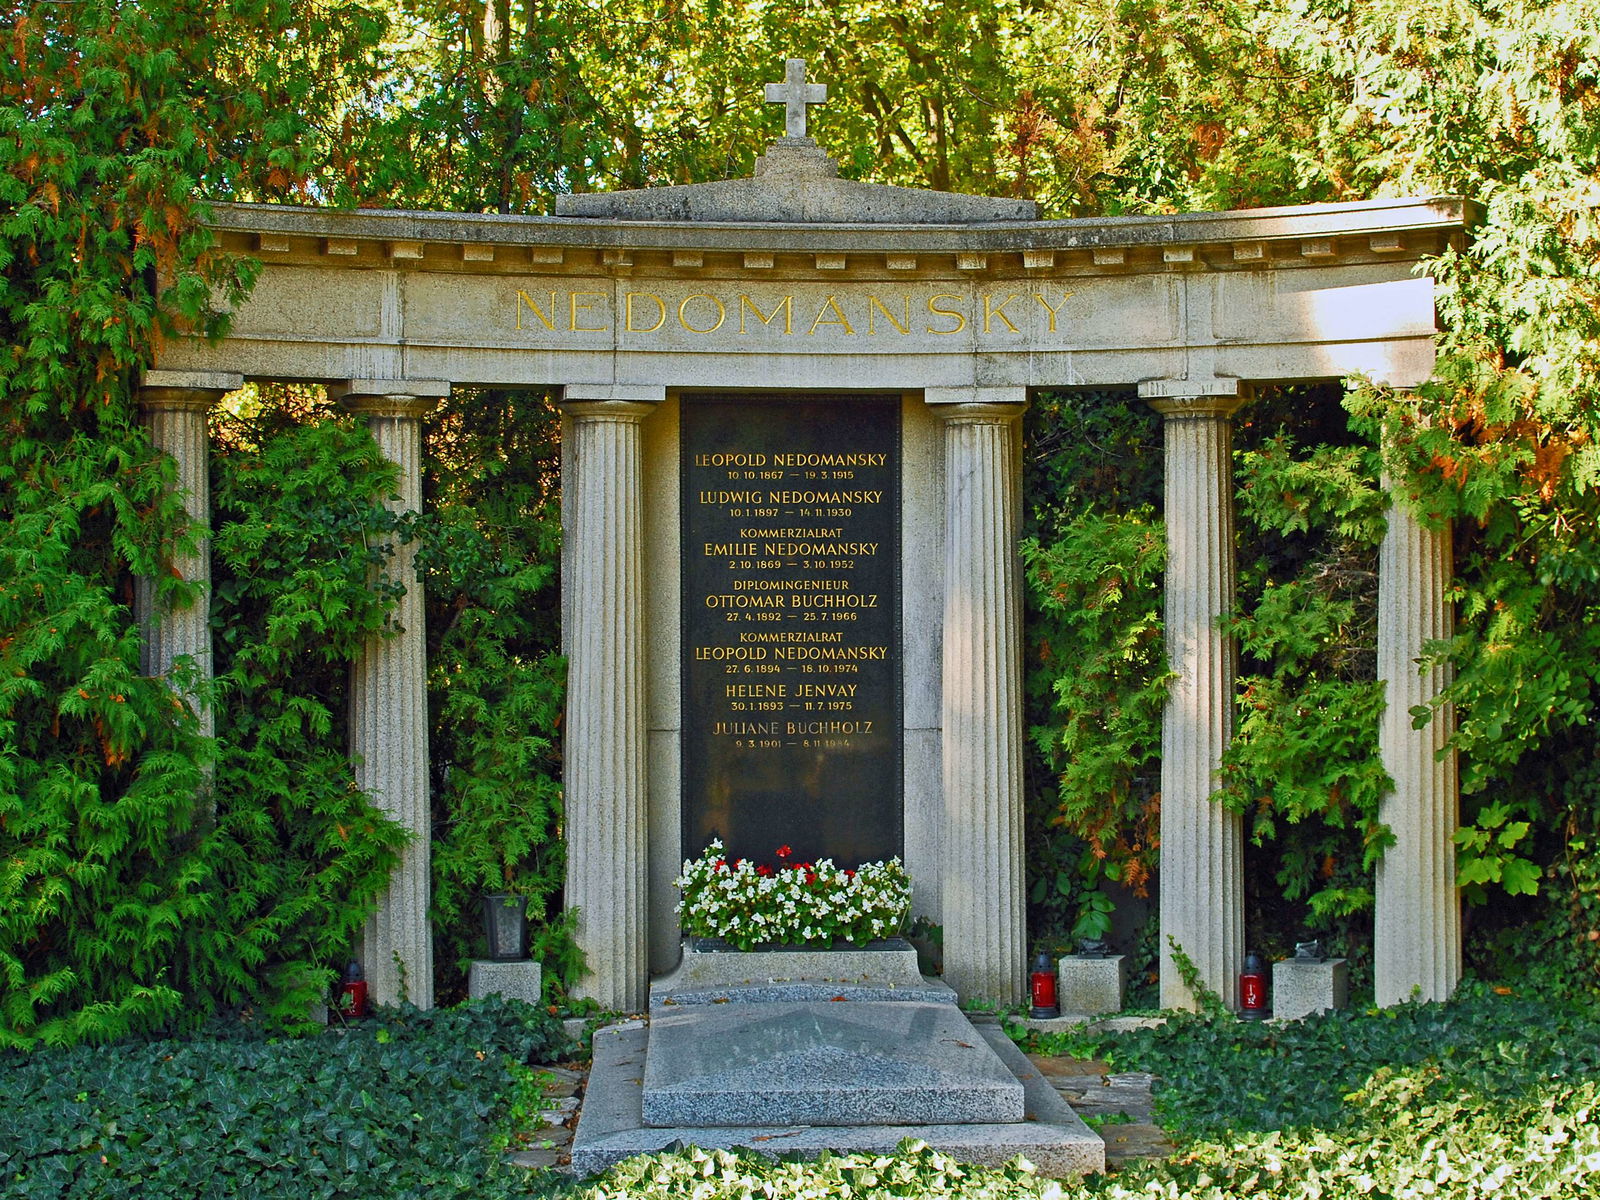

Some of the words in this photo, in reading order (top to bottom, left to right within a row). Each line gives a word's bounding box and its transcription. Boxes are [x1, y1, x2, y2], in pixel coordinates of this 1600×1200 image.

[514, 289, 1075, 336] NEDOMANSKY
[695, 454, 766, 467] LEOPOLD
[774, 454, 887, 467] NEDOMANSKY
[699, 491, 763, 504] LUDWIG
[769, 491, 883, 504] NEDOMANSKY
[740, 528, 844, 538] KOMMERZIALRAT
[704, 543, 758, 556] EMILIE
[765, 543, 879, 556] NEDOMANSKY
[733, 580, 850, 590] DIPLOMINGENIEUR
[705, 595, 785, 608] OTTOMAR
[792, 595, 878, 608] BUCHHOLZ
[740, 632, 844, 643] KOMMERZIALRAT
[695, 647, 767, 660] LEOPOLD
[774, 647, 889, 660] NEDOMANSKY
[726, 685, 786, 697] HELENE
[795, 685, 858, 697] JENVAY
[712, 722, 779, 735] JULIANE
[787, 722, 874, 735] BUCHHOLZ
